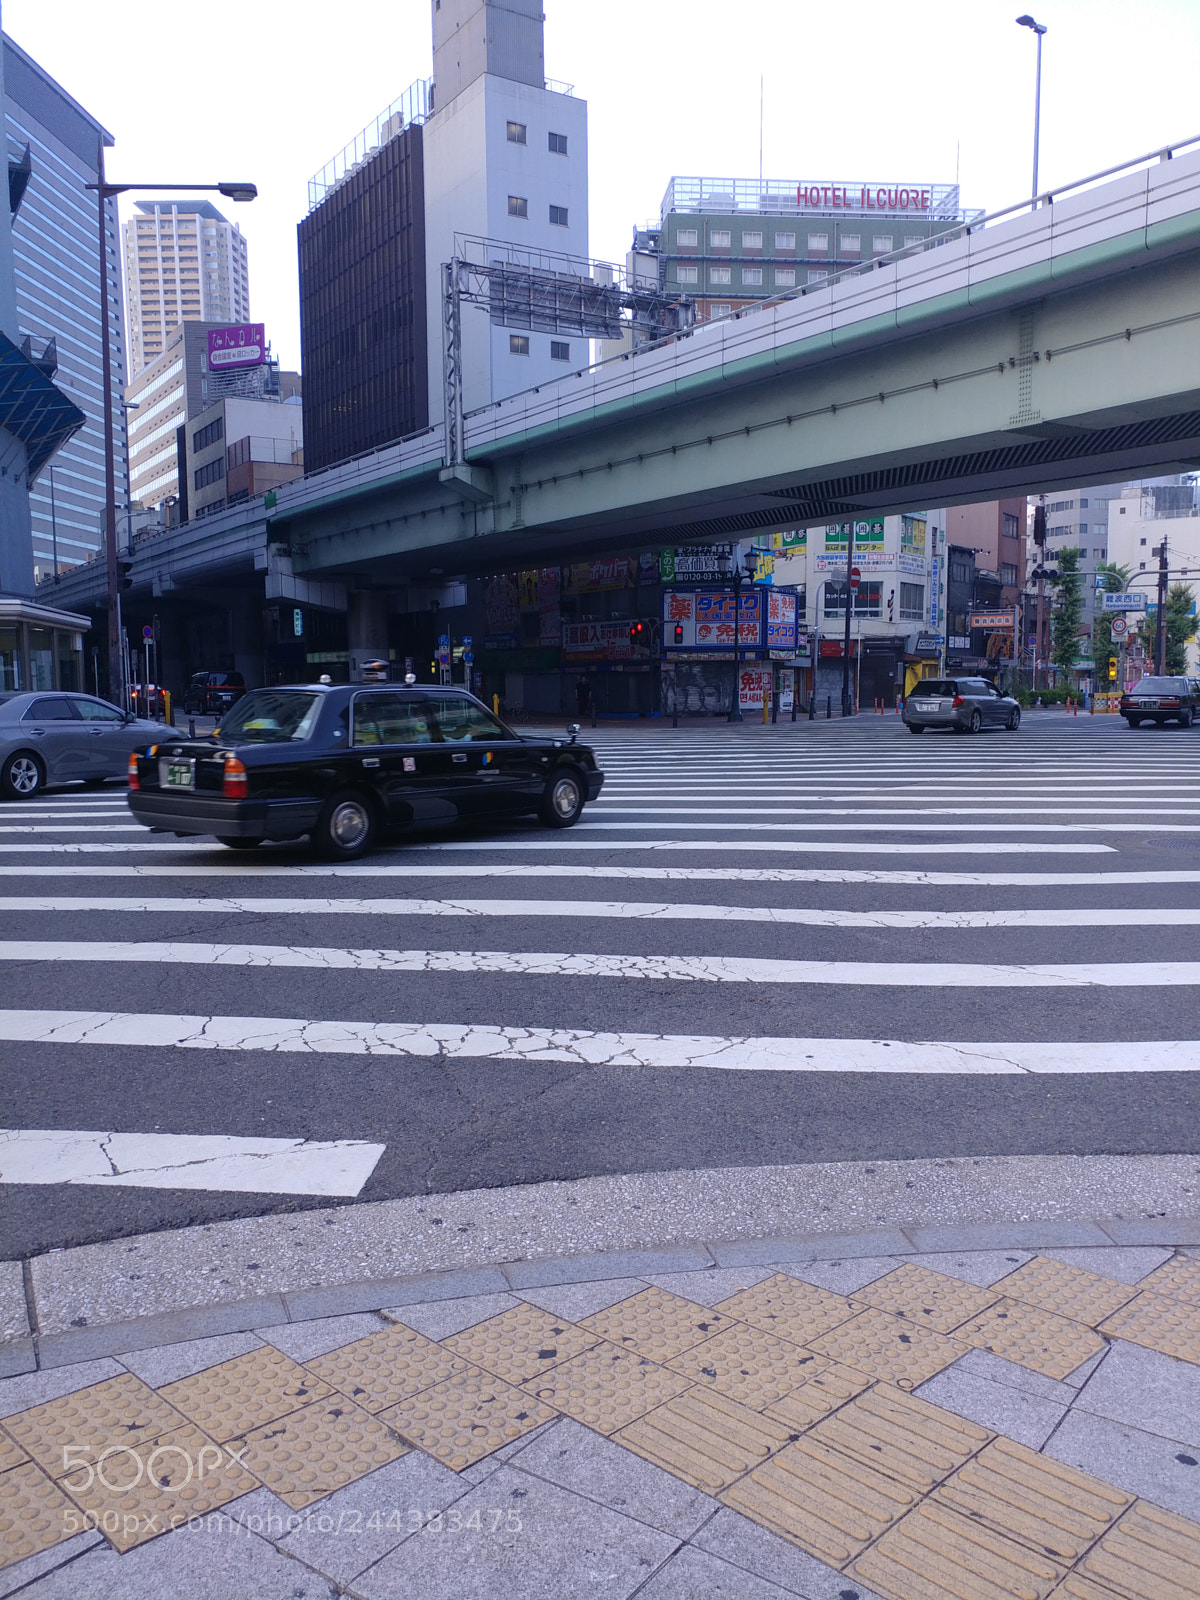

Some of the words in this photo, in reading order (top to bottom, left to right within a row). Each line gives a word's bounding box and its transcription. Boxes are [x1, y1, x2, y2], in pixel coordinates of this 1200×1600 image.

[797, 187, 851, 206] HOTEL
[861, 188, 930, 209] ILCUORE
[590, 558, 629, 581] ポケパラ
[663, 550, 673, 575] この下
[669, 594, 692, 620] 薬
[698, 596, 759, 611] ダイコク
[769, 593, 779, 620] 薬
[782, 597, 794, 610] 免税
[1106, 595, 1142, 603] 難波西口
[716, 624, 759, 637] 免税
[768, 624, 795, 637] ダイコク
[1115, 622, 1124, 630] 60
[740, 672, 763, 692] 免税
